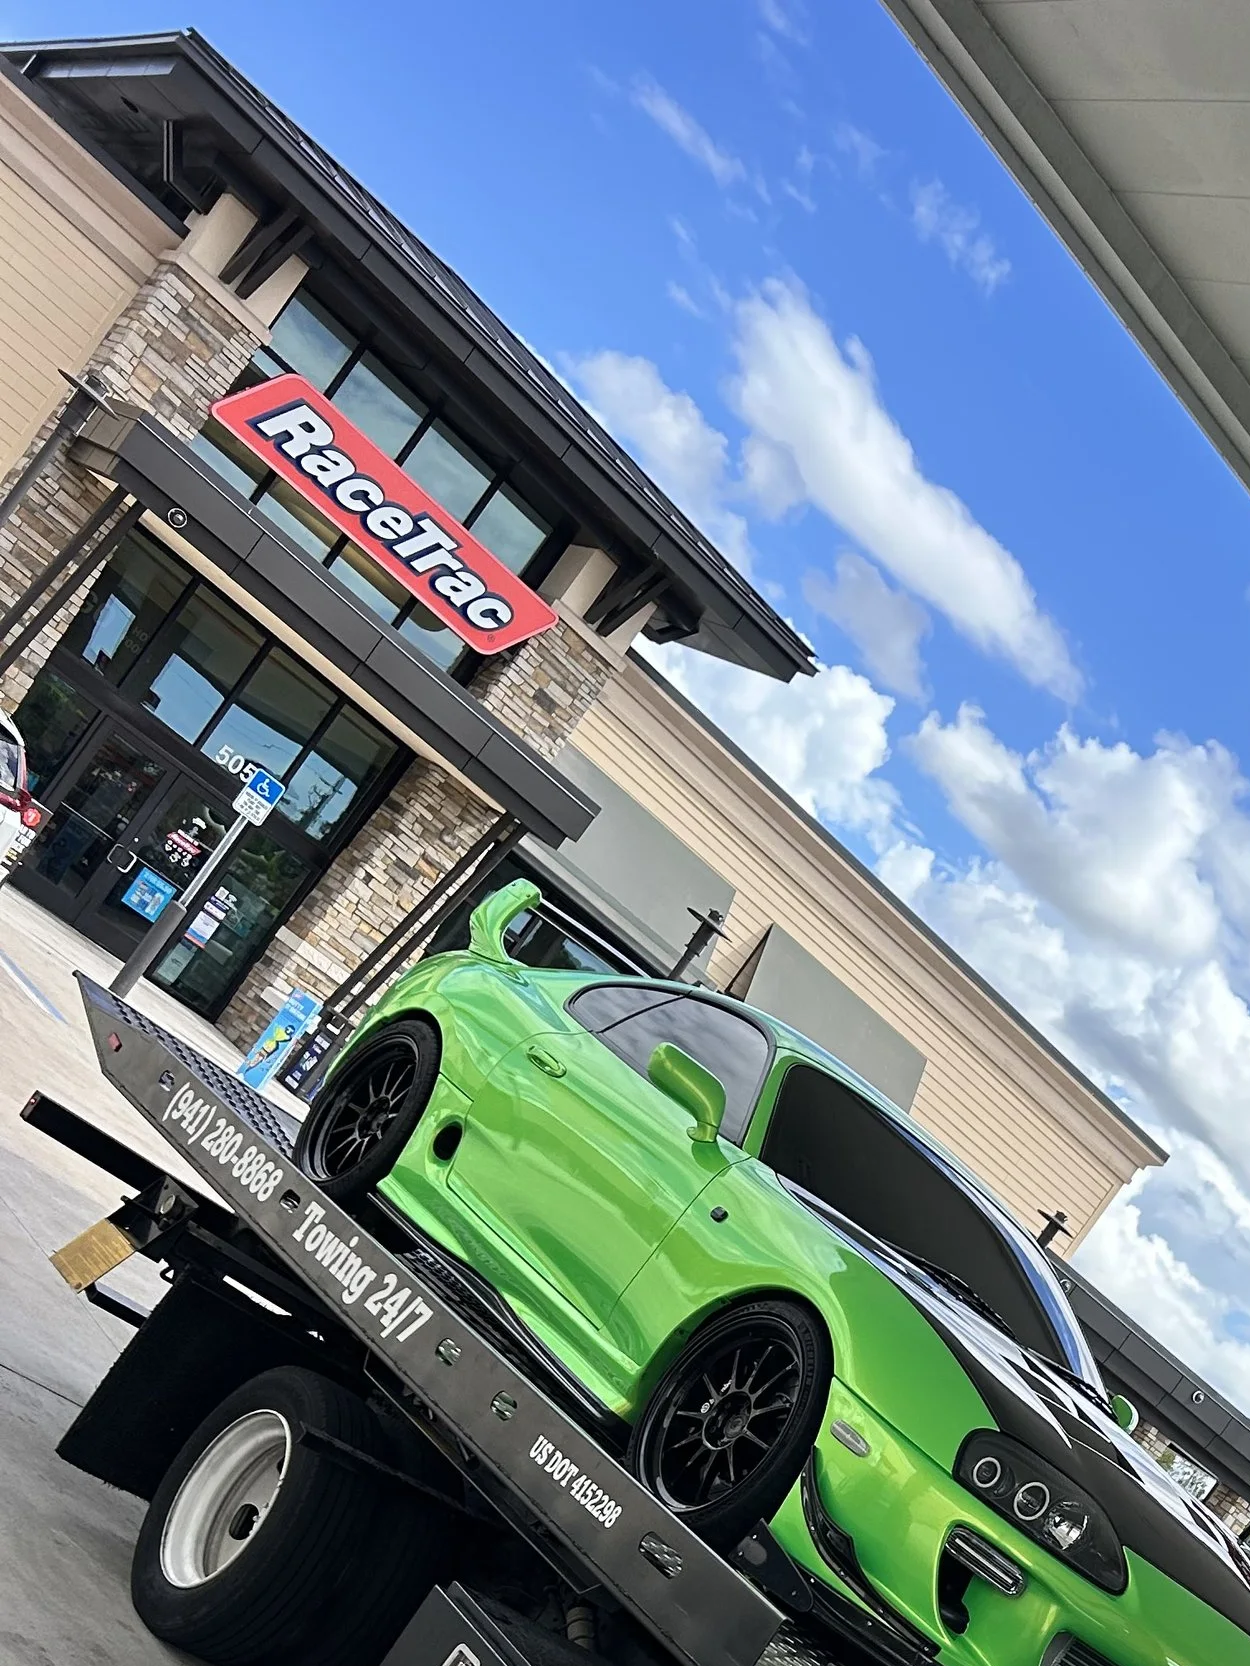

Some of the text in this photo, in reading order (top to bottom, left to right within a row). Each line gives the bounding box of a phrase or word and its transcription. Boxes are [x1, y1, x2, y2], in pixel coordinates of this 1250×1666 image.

[250, 400, 514, 630] RaceTrac
[162, 1082, 283, 1202] (941) 280-8868
[292, 1201, 434, 1342] Towing 24/7
[529, 1434, 623, 1528] US DOT 4152298
